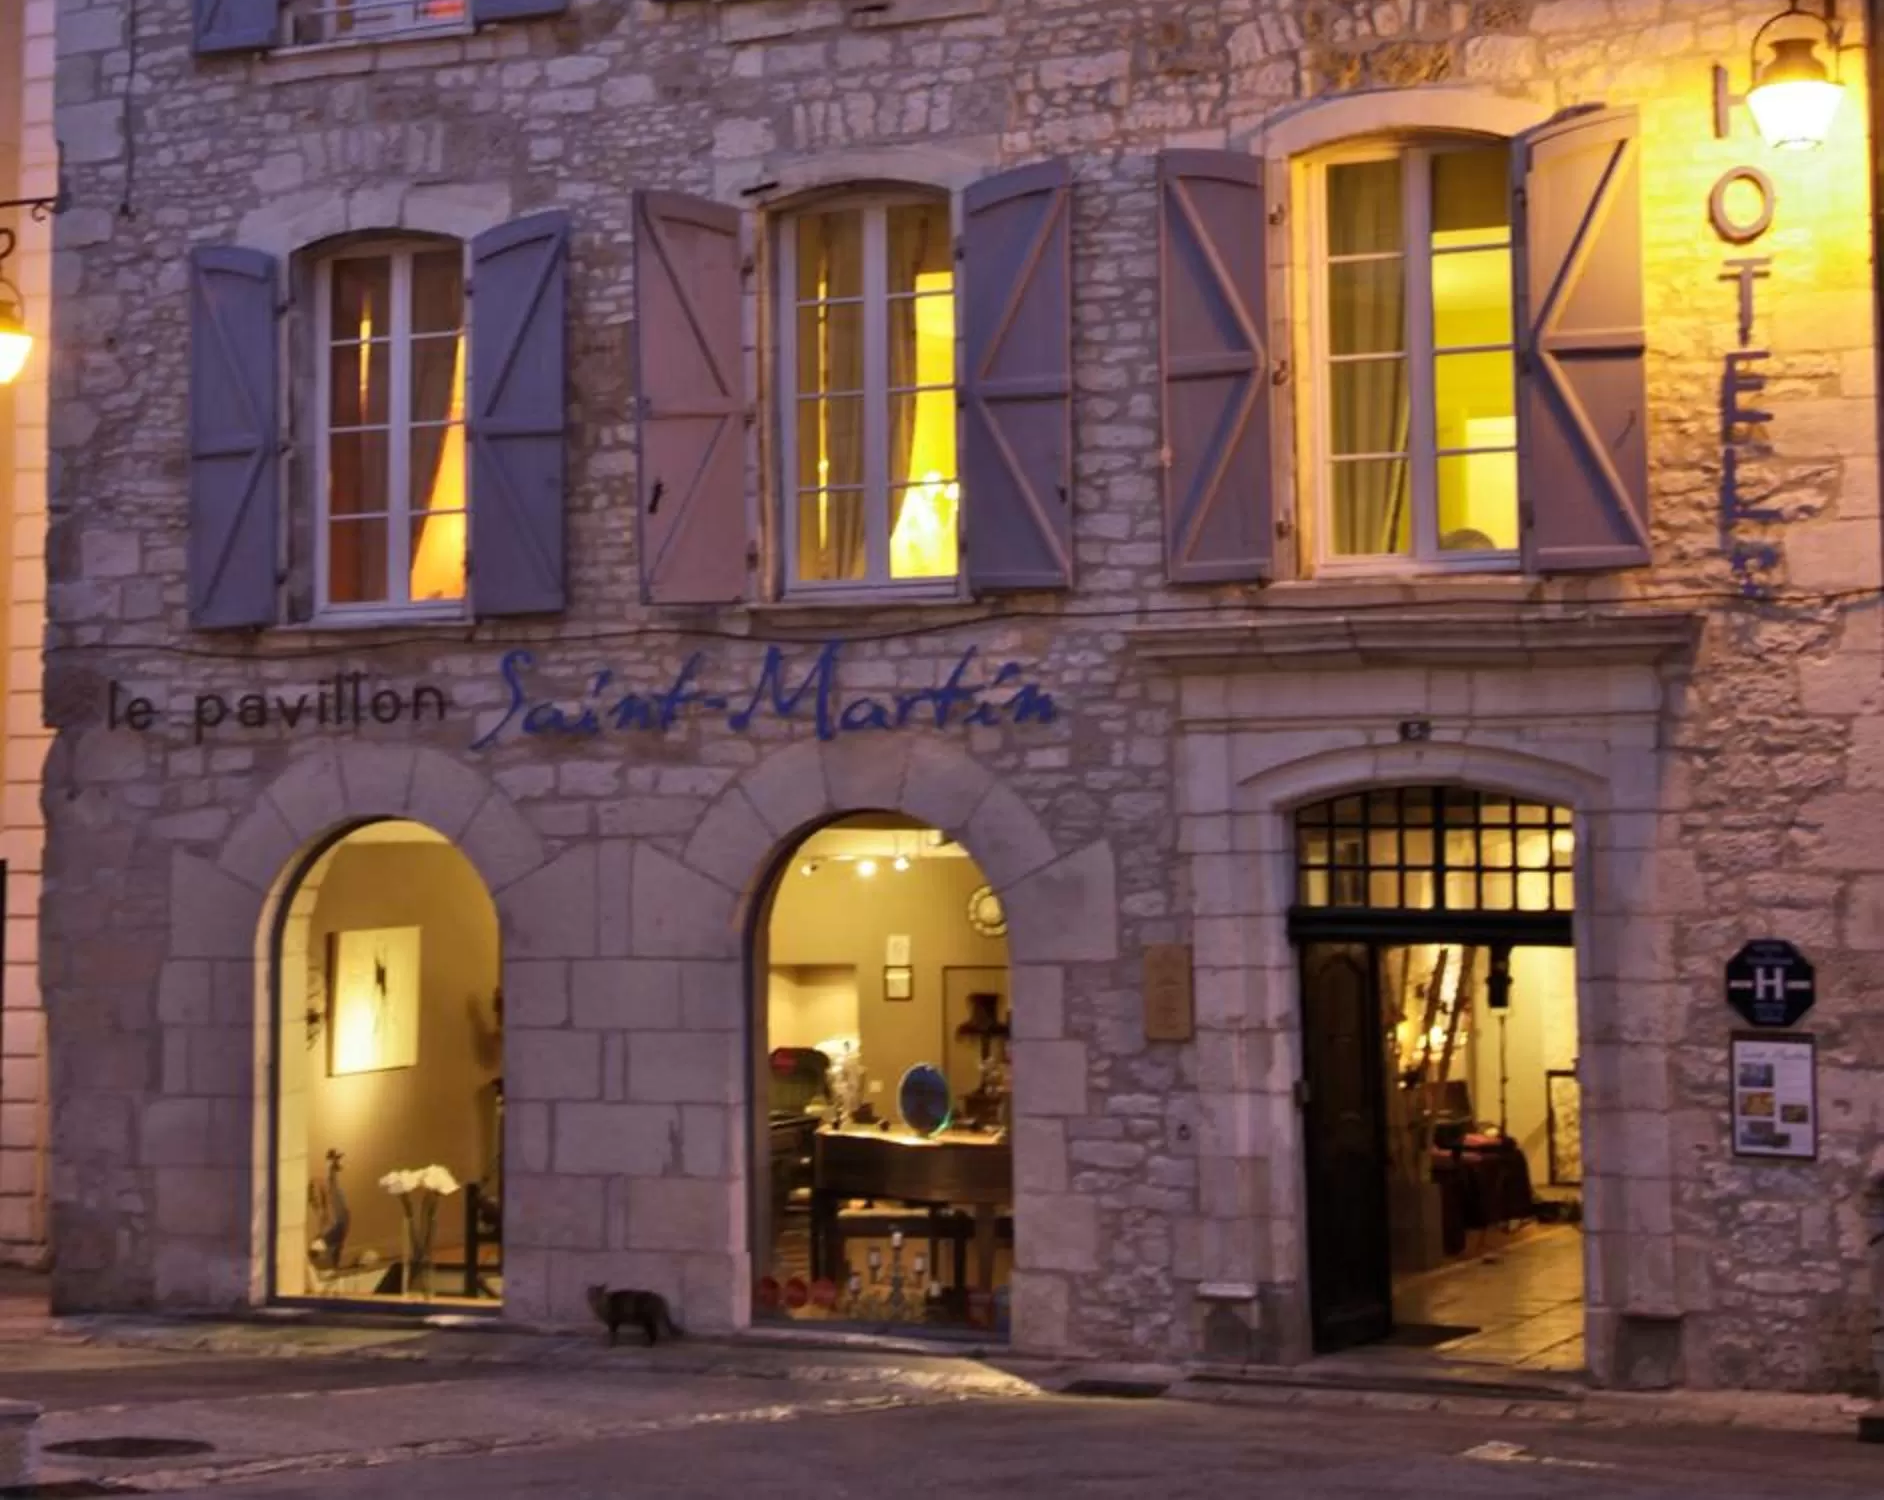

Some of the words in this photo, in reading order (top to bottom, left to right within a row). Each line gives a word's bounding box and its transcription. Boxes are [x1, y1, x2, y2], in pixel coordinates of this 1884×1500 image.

[108, 679, 155, 731] le
[194, 670, 446, 745] pavillon
[468, 638, 1058, 750] Saint-Martin
[1755, 966, 1785, 1000] H
